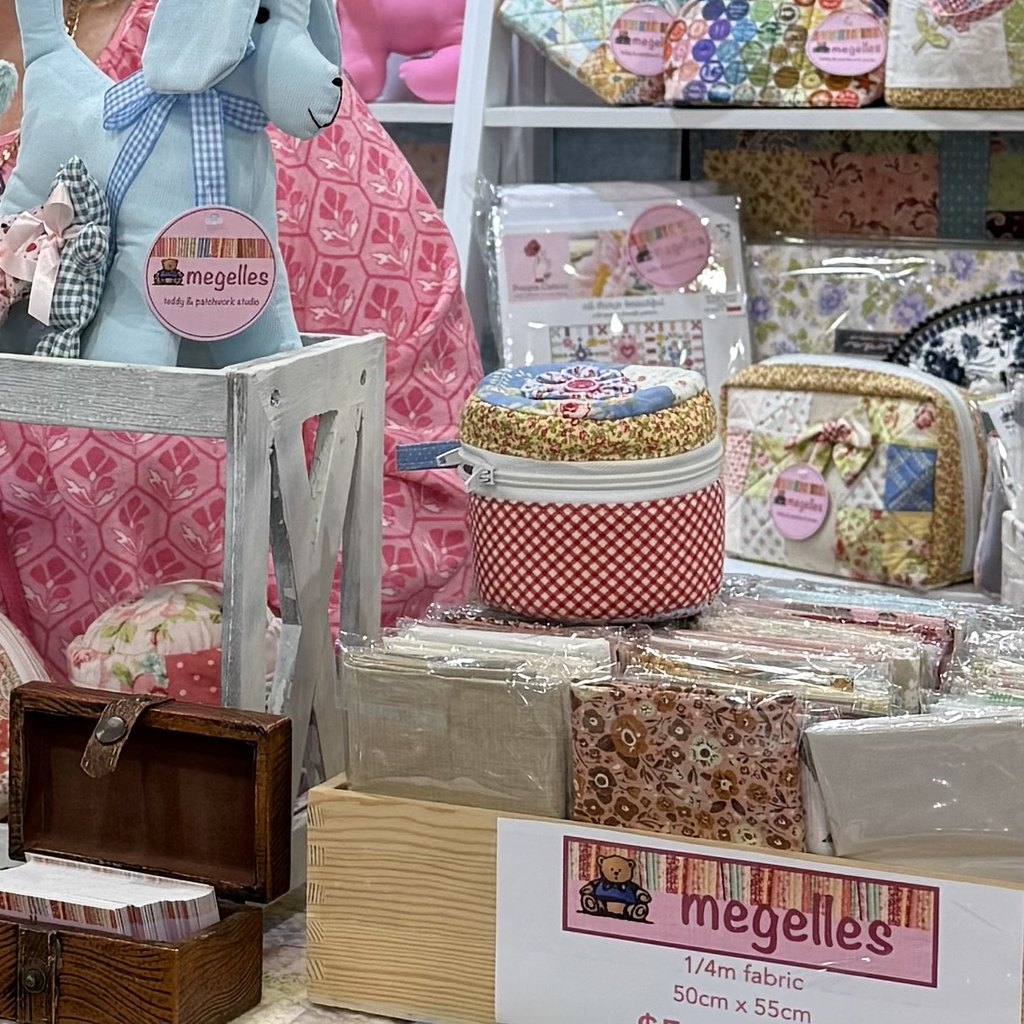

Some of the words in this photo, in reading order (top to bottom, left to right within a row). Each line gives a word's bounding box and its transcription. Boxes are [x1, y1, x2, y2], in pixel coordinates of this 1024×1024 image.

[186, 264, 269, 292] megelles
[164, 296, 185, 308] teddy
[186, 296, 194, 306] &
[196, 296, 235, 307] patchwork
[237, 297, 260, 306] studio
[681, 893, 894, 956] megelles
[684, 956, 736, 980] 1/4m
[743, 964, 804, 991] fabric
[673, 984, 728, 1010] 50cm
[735, 1000, 748, 1014] x
[754, 998, 812, 1024] 55cm
